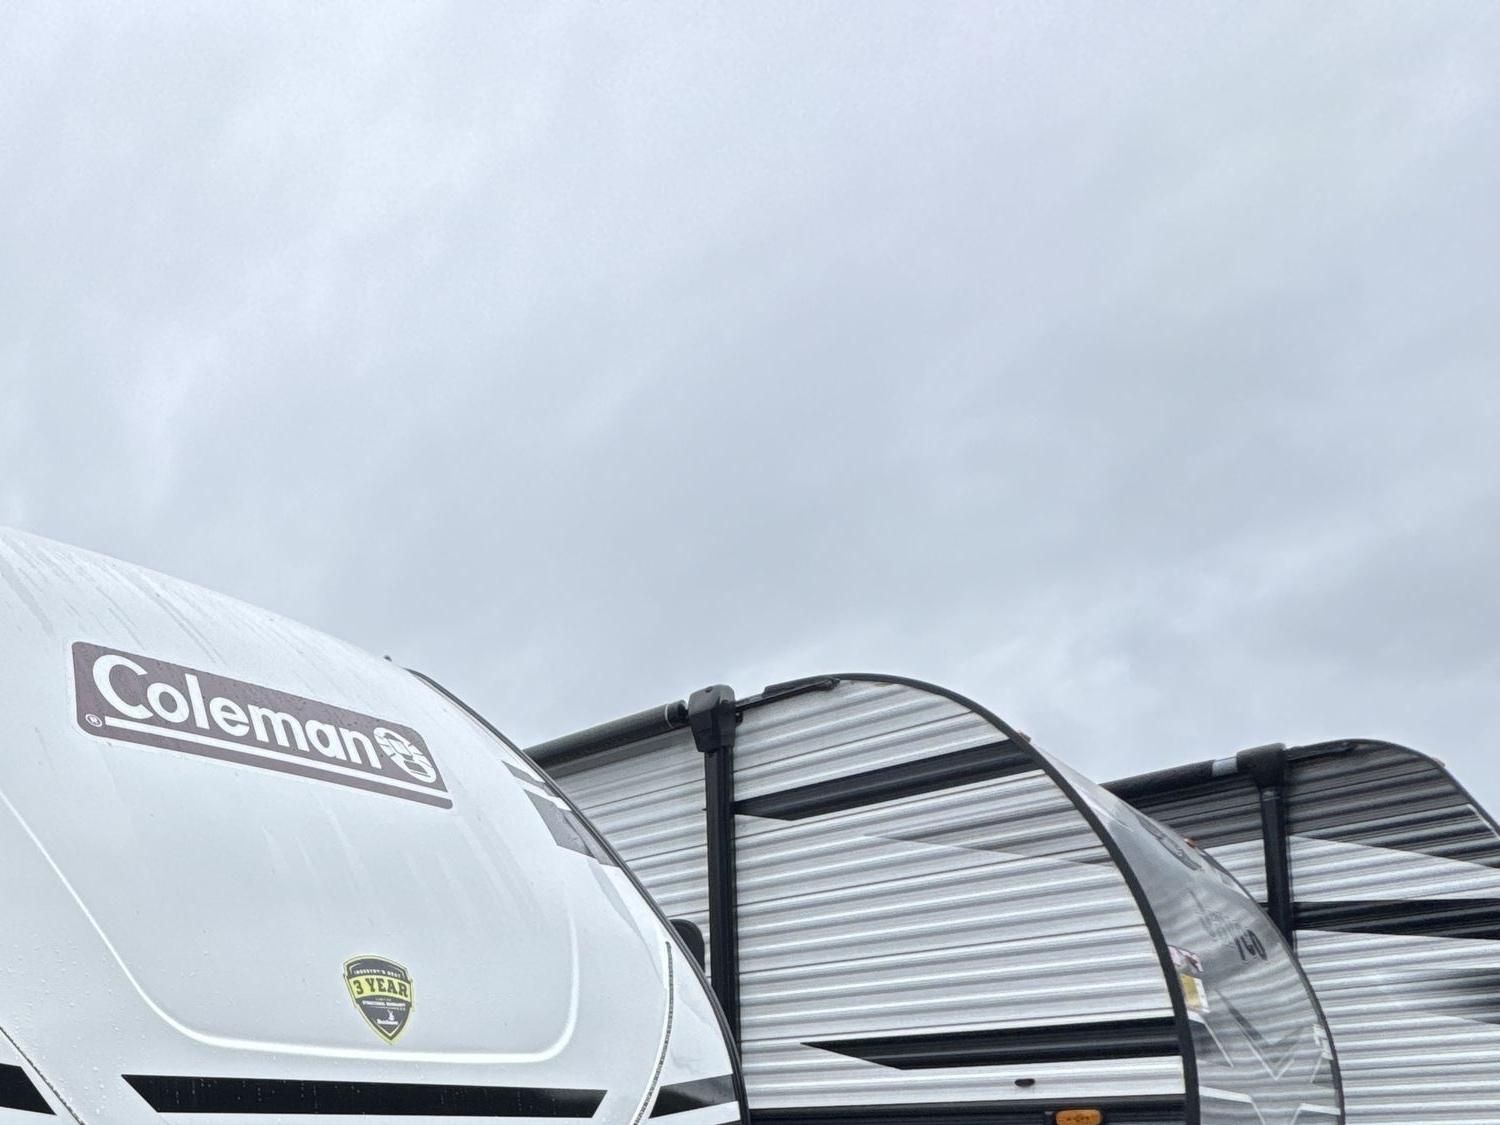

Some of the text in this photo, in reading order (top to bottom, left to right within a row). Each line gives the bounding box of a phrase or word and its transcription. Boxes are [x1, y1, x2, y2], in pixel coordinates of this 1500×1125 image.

[92, 654, 382, 769] Coleman
[353, 977, 409, 998] 3 YEAR
